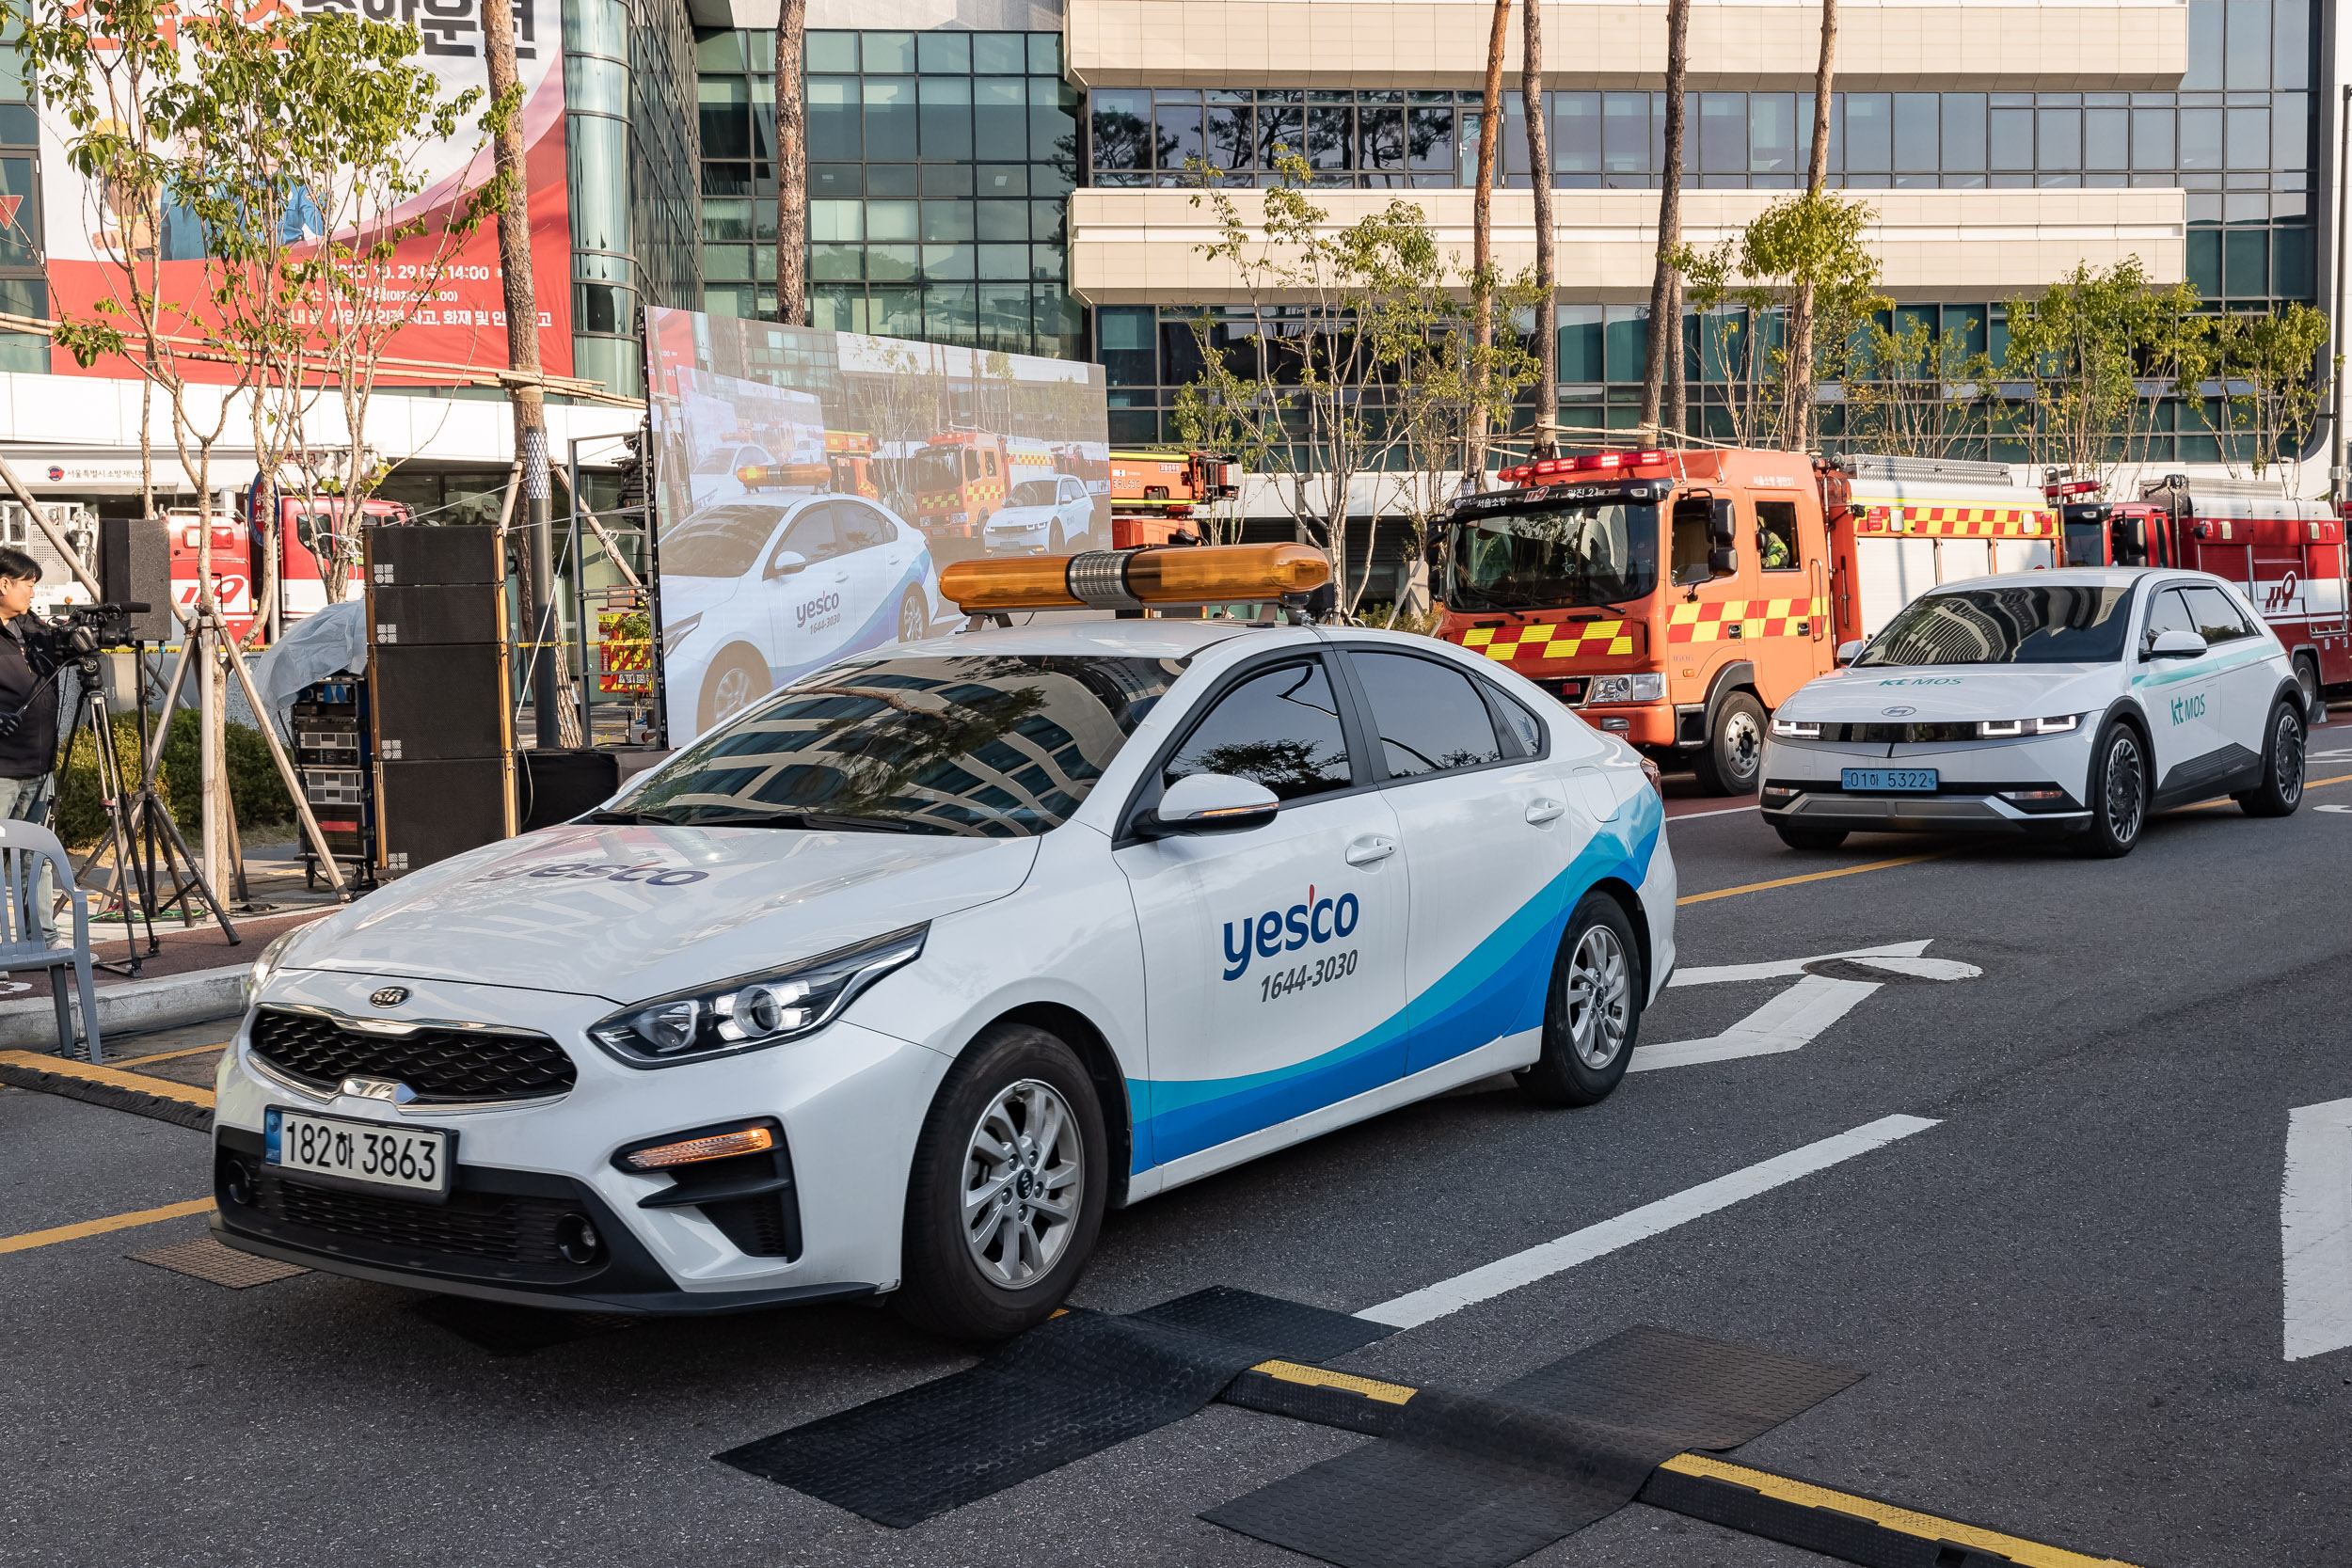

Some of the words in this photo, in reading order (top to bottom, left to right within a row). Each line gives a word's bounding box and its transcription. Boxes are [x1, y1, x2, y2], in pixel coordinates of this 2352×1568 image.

[447, 265, 489, 280] 14:00
[442, 309, 472, 326] 화재
[474, 309, 489, 326] 및
[67, 468, 105, 479] 서울특별시
[107, 468, 152, 479] 소방재난본
[1477, 496, 1507, 509] 서울소방
[1524, 486, 1549, 502] 119
[1588, 487, 1599, 498] 21
[2265, 570, 2296, 613] 119
[1879, 678, 1911, 687] kt
[1912, 677, 1964, 686] MOS
[2170, 697, 2184, 727] kt
[2185, 693, 2206, 722] MOS
[1851, 772, 1879, 788] 01하
[1887, 772, 1928, 788] 5322
[1261, 949, 1359, 1003] 1644-3030
[286, 1120, 355, 1169] 182하
[362, 1132, 437, 1182] 3863
